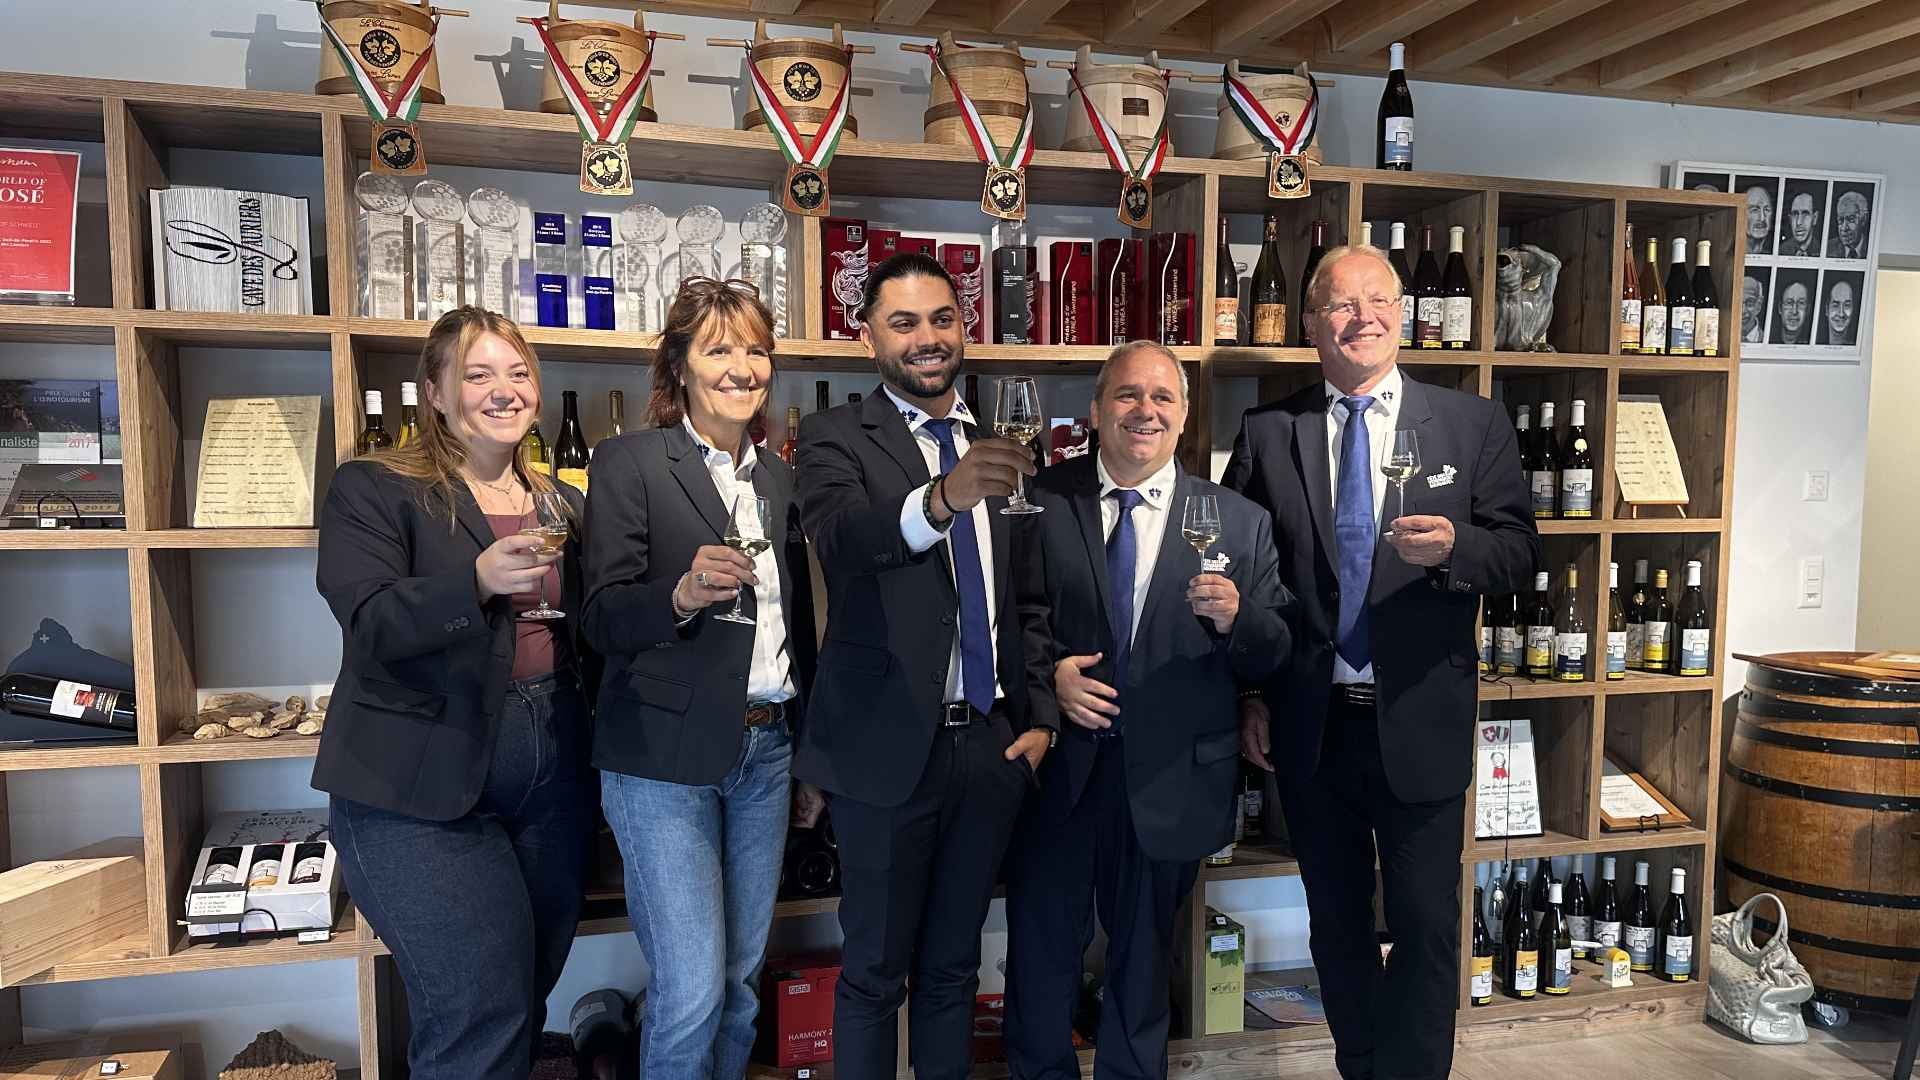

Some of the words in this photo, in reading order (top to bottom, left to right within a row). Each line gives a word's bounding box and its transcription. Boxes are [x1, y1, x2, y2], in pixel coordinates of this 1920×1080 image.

[30, 178, 47, 187] OF
[240, 255, 264, 276] DES
[241, 278, 265, 307] CAVE
[69, 439, 91, 449] 2017
[788, 1030, 827, 1041] HARMONY
[815, 1040, 828, 1049] HQ
